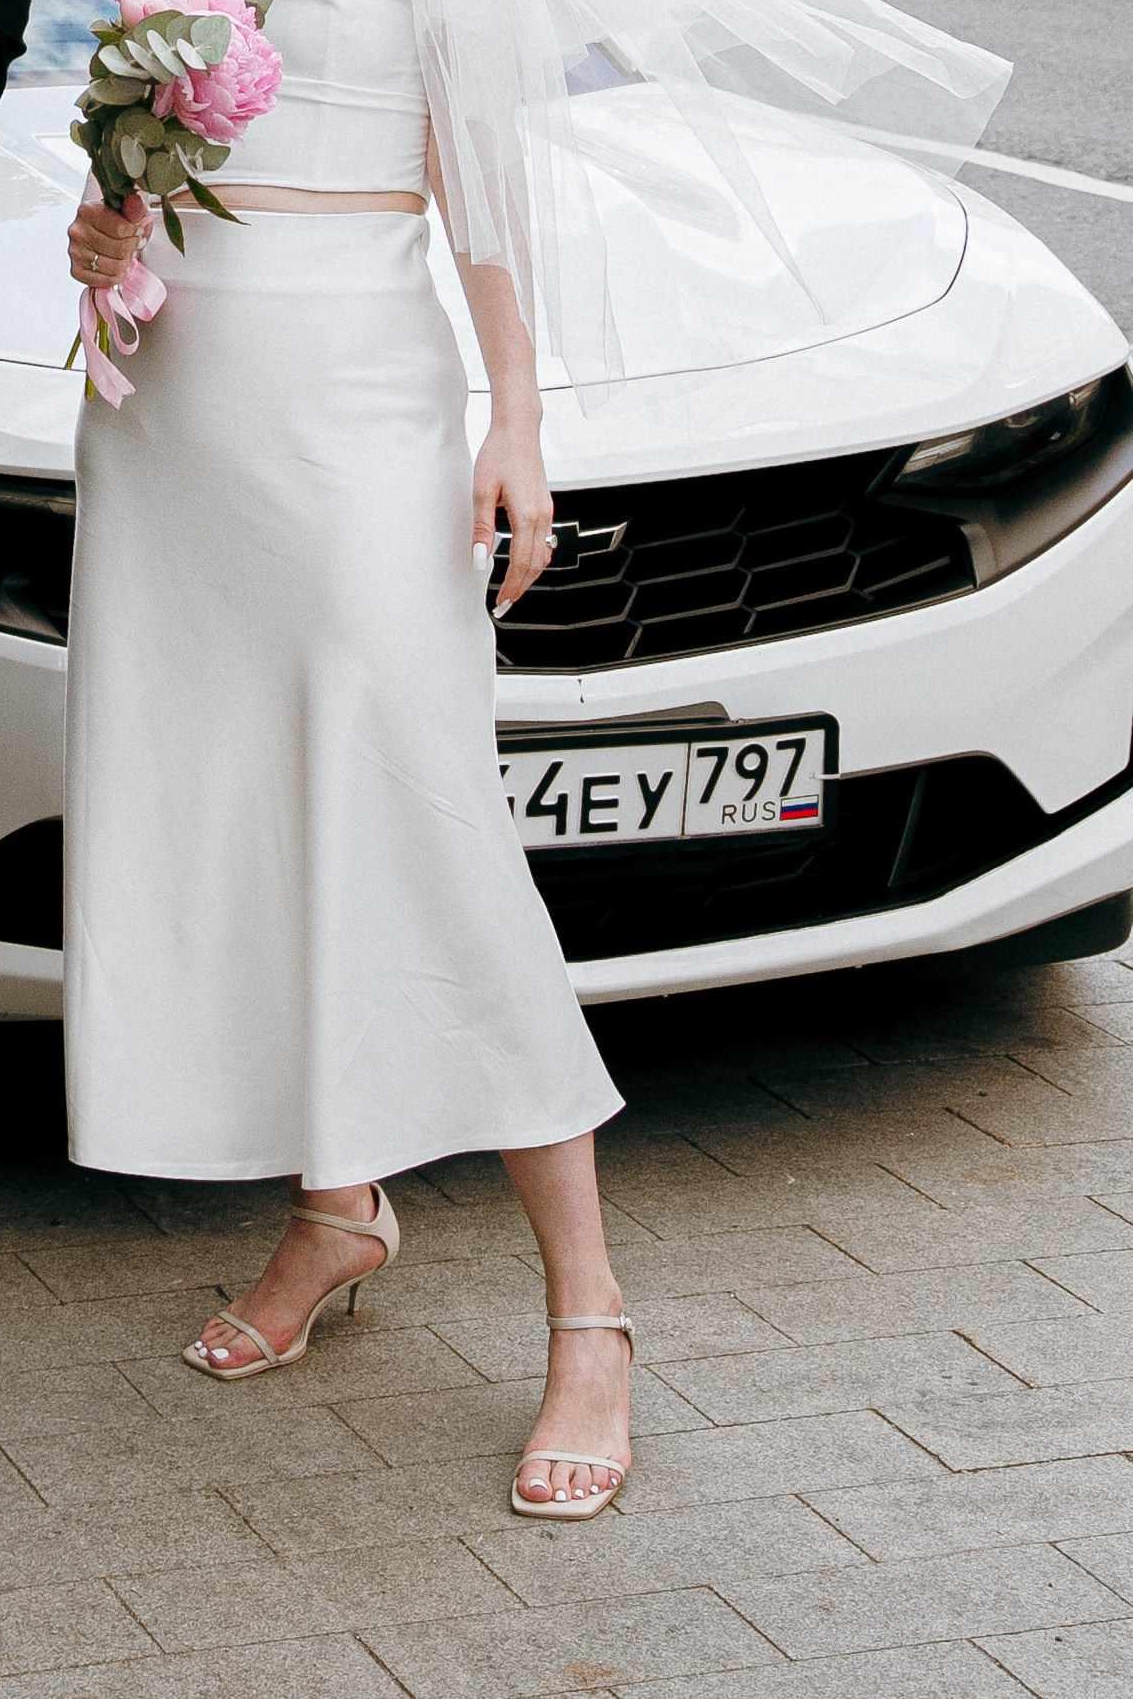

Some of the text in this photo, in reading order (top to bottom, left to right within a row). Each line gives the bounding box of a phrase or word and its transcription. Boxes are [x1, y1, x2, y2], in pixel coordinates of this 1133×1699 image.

[499, 737, 807, 837] 4EY 797
[721, 800, 776, 825] RUS
